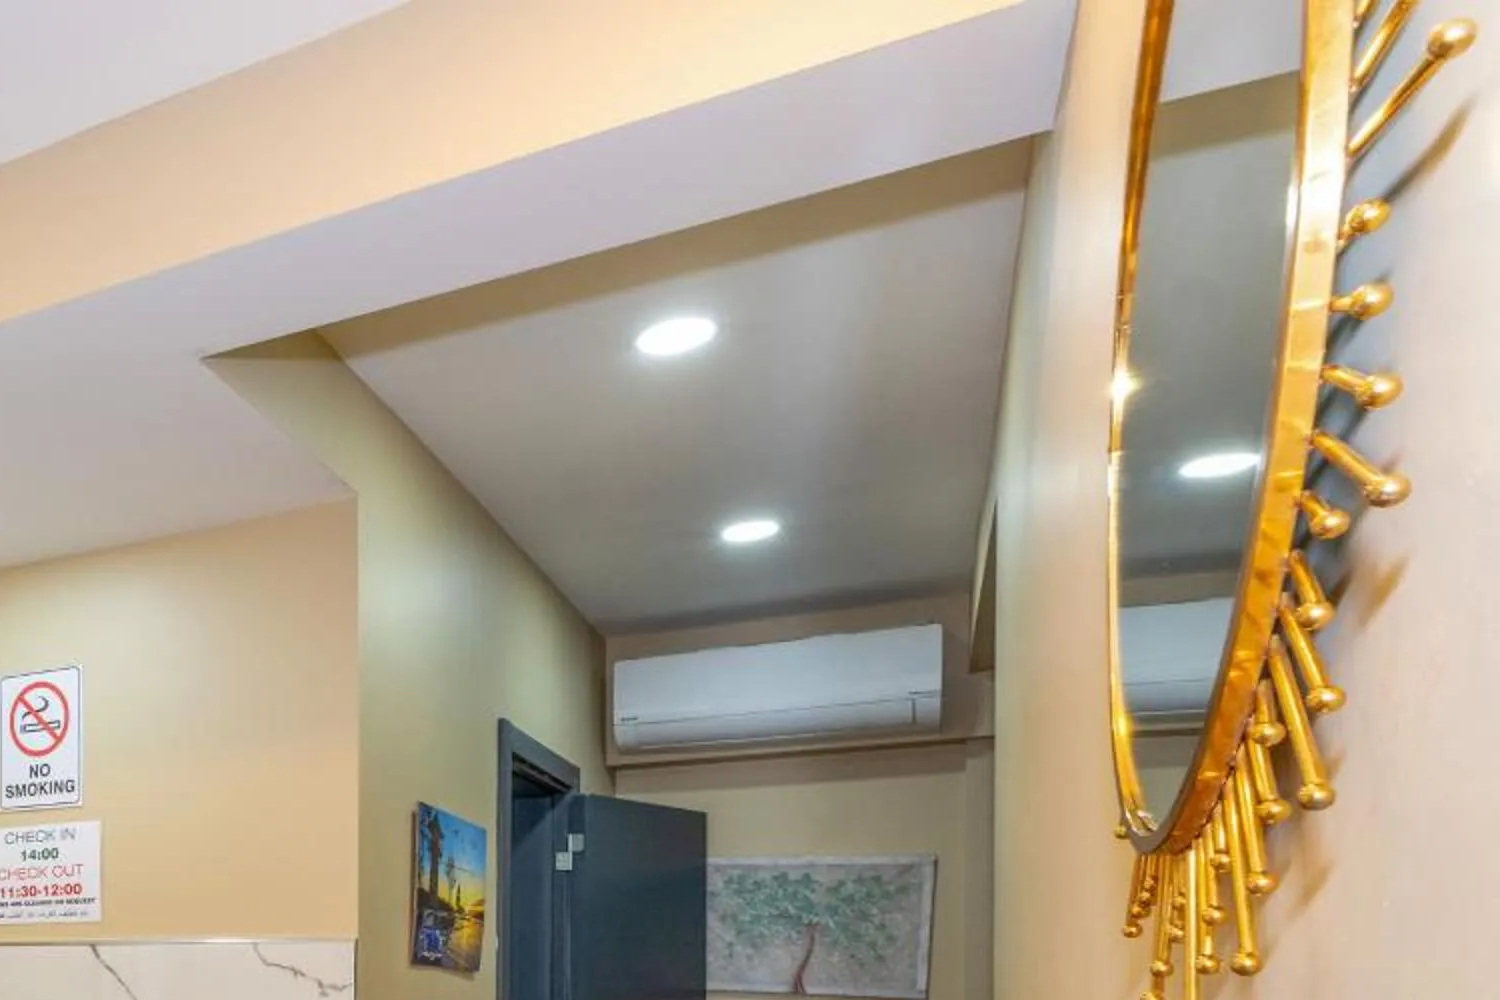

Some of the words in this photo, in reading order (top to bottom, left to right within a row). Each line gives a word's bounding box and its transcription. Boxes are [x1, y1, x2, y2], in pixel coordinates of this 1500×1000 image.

[29, 763, 51, 778] NO
[5, 780, 75, 799] SMOKING
[4, 829, 55, 845] CHECK
[60, 827, 76, 841] IN
[21, 847, 59, 861] 14:00
[52, 863, 84, 878] OUT
[0, 883, 83, 899] 11:30-12:00
